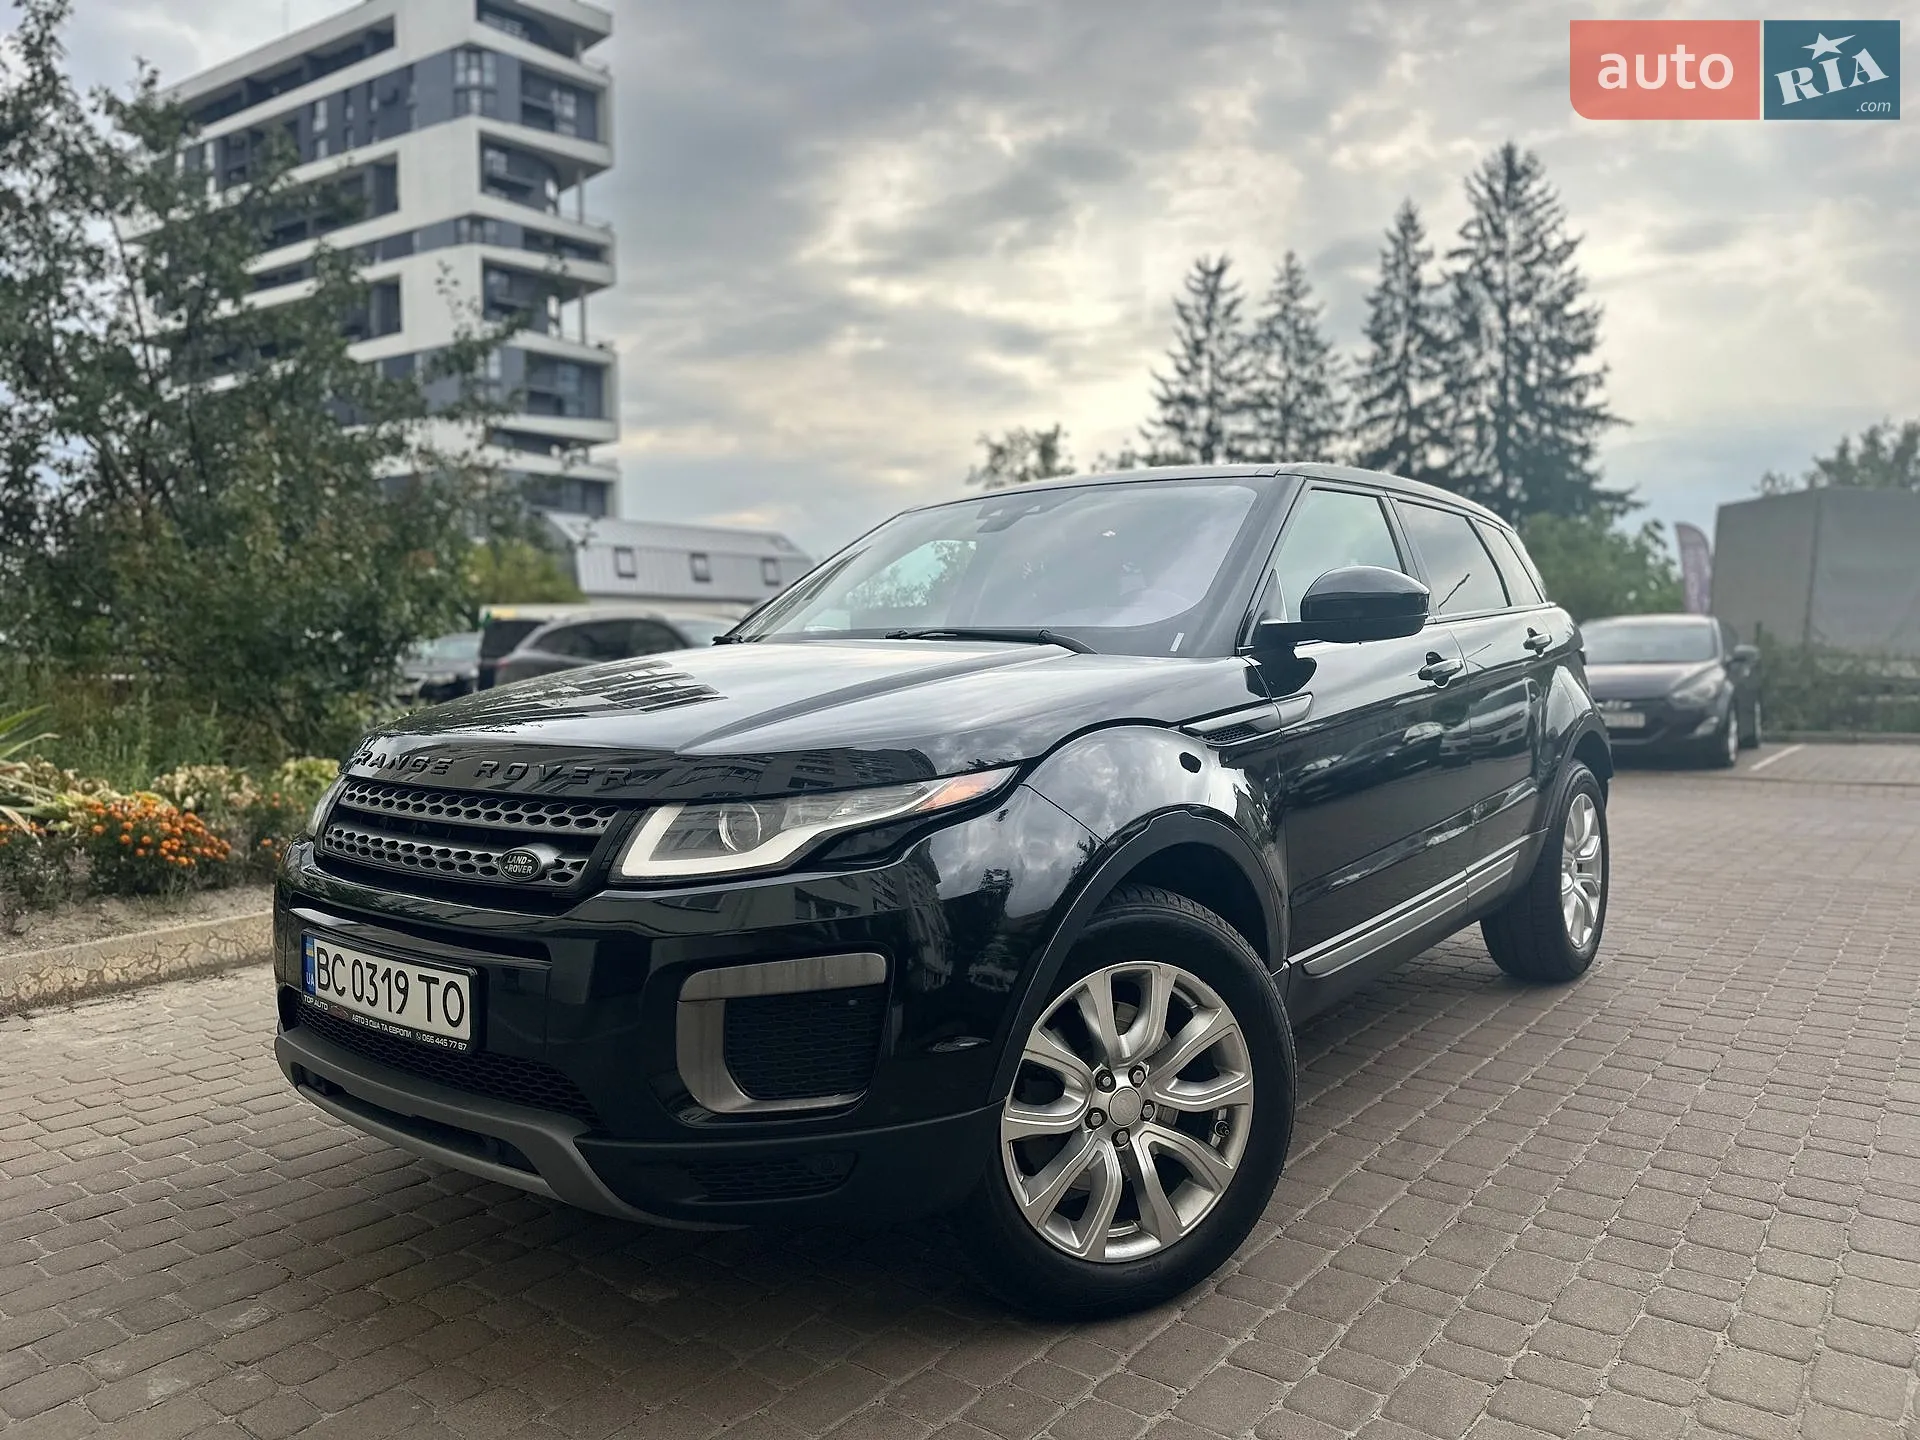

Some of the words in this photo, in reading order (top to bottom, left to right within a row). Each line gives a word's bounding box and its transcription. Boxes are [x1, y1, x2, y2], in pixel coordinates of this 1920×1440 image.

[354, 750, 454, 775] RANGE
[473, 760, 632, 785] ROVER
[306, 971, 315, 987] UA
[316, 946, 346, 997] BC
[351, 958, 409, 1014] 0319
[417, 974, 465, 1028] TO
